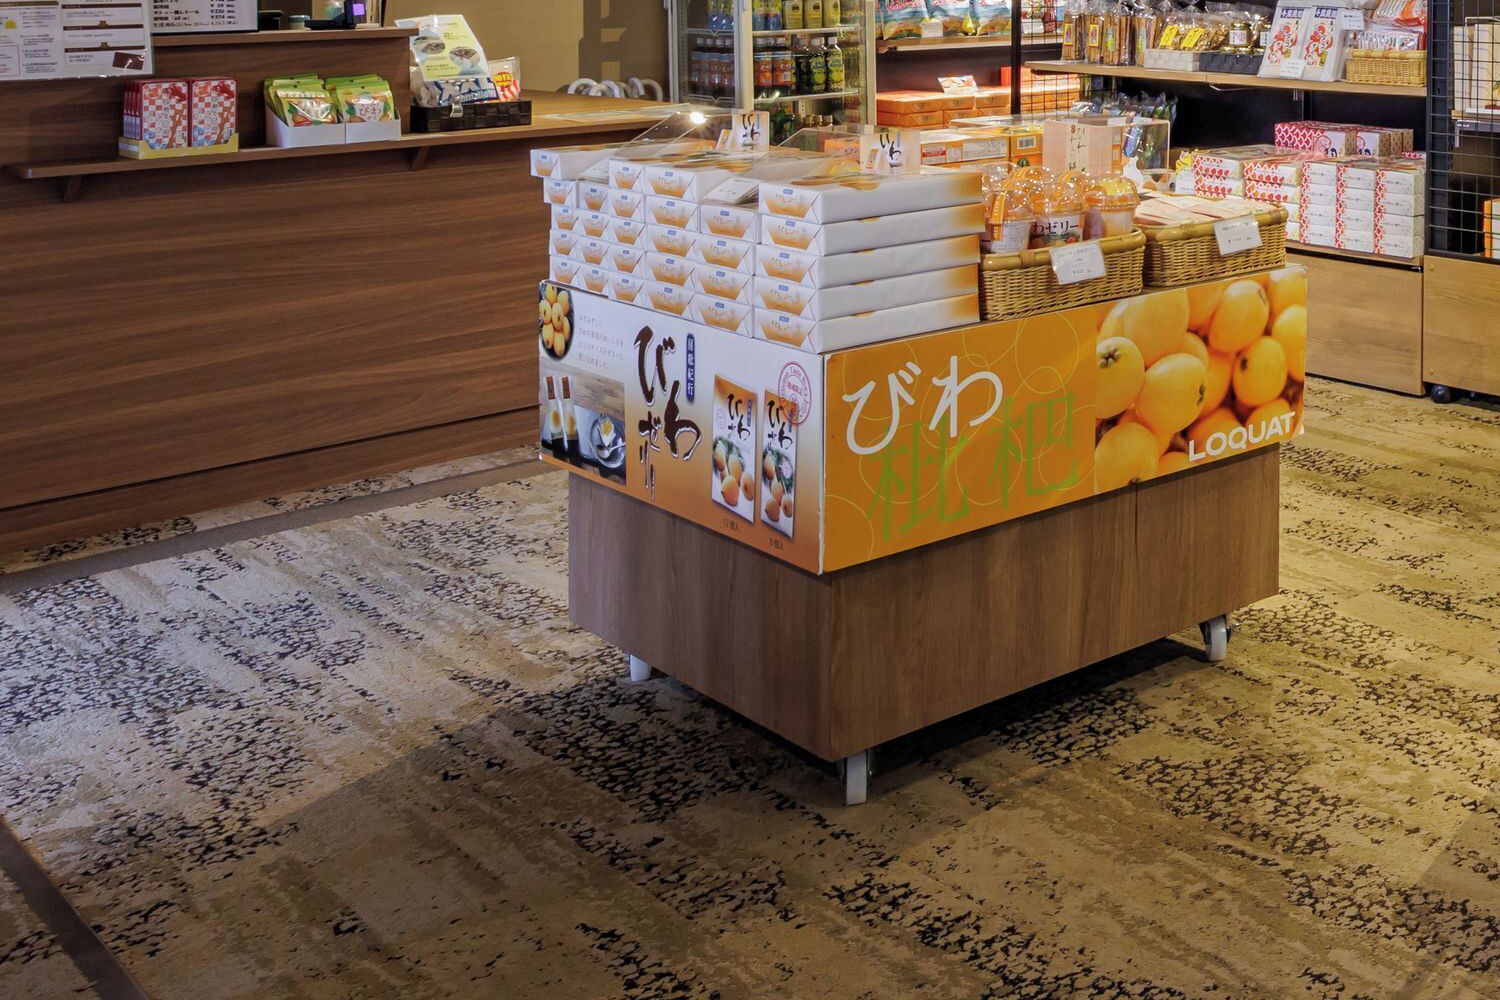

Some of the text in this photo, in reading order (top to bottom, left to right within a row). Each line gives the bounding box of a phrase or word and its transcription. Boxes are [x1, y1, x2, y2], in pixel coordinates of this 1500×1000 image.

[843, 355, 1003, 455] びわ
[1188, 411, 1296, 462] LOQUAT
[867, 391, 1079, 542] 枇杷
